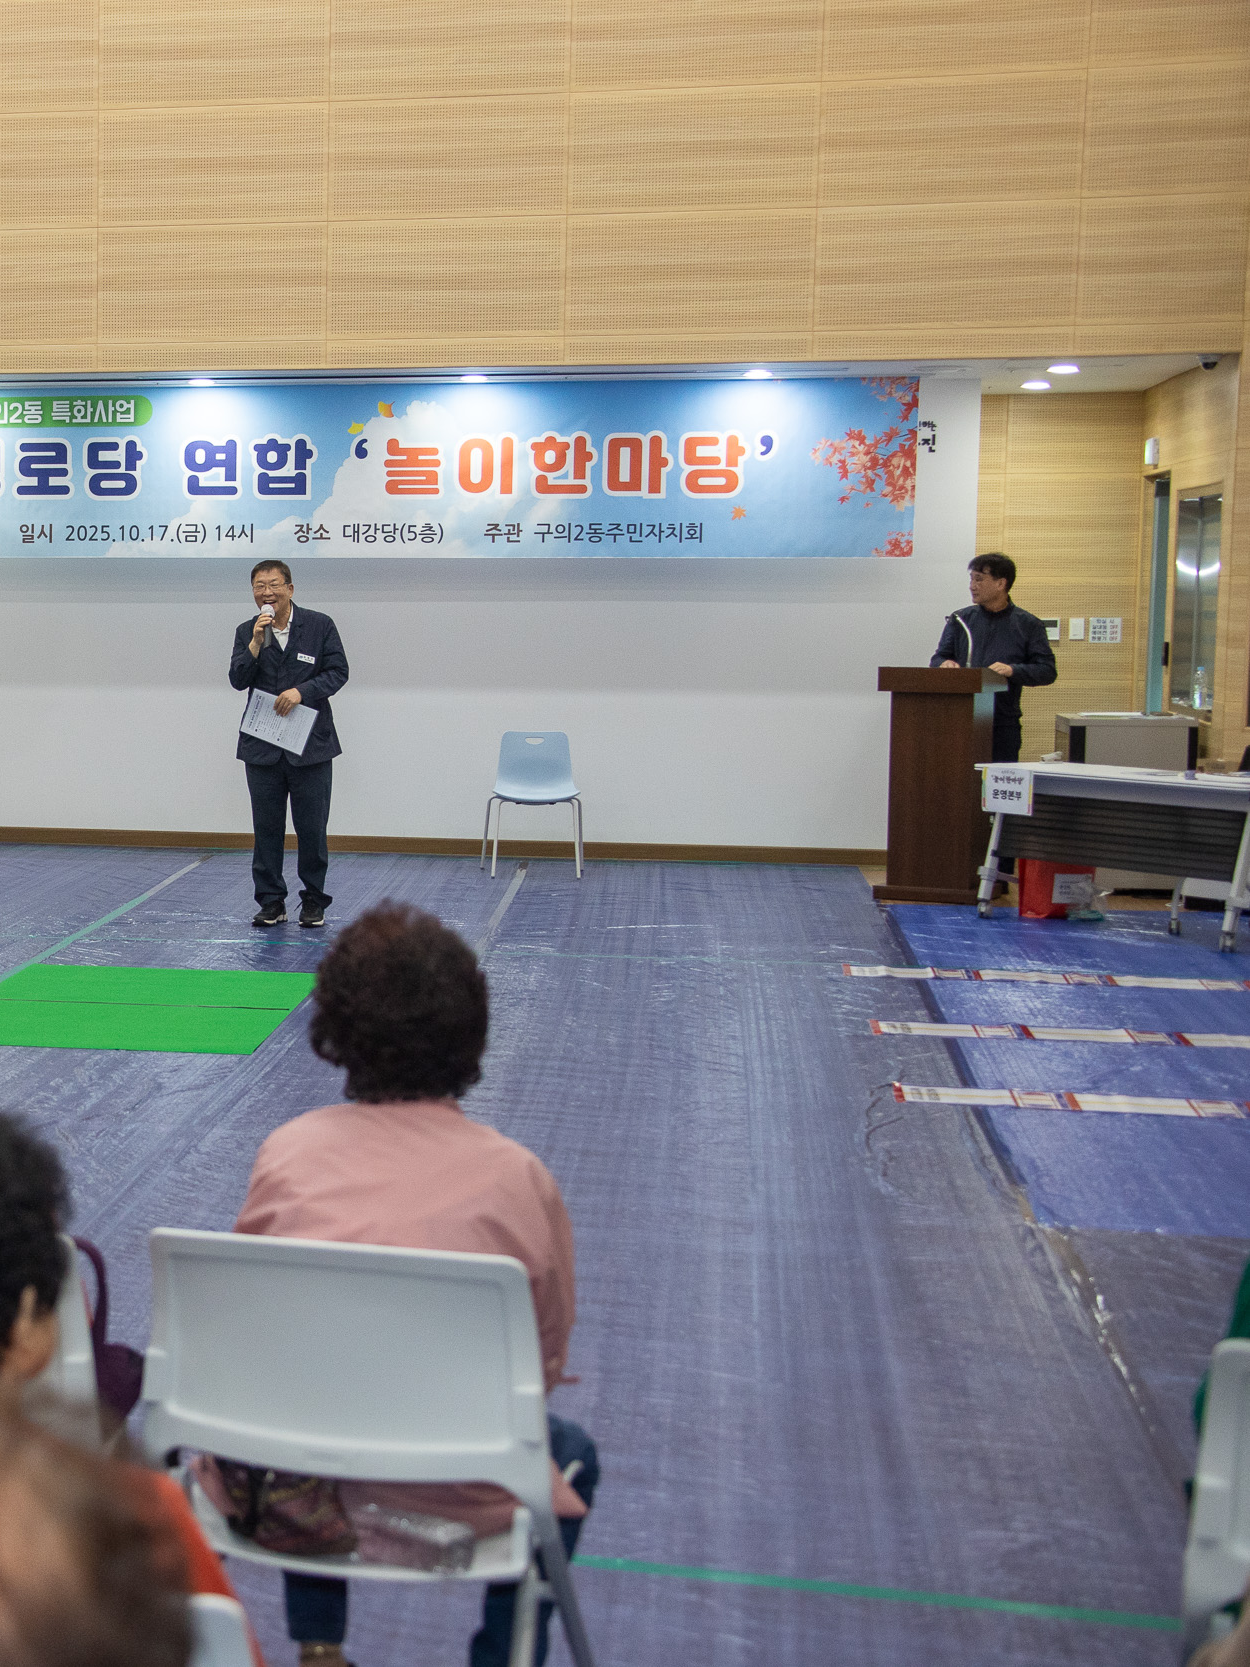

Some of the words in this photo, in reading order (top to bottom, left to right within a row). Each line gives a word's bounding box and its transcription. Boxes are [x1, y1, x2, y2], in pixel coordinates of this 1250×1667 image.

[51, 400, 135, 423] 특화사업
[184, 438, 314, 496] 연합
[19, 523, 53, 544] 일시
[65, 523, 207, 544] 2025.10.17.(금)
[215, 523, 254, 543] 14시
[293, 523, 331, 543] 장소
[342, 522, 444, 544] 대강당(5층)
[483, 522, 523, 543] 주관
[533, 522, 703, 543] 구의2동주민자치회
[992, 788, 1022, 801] 운영본부
